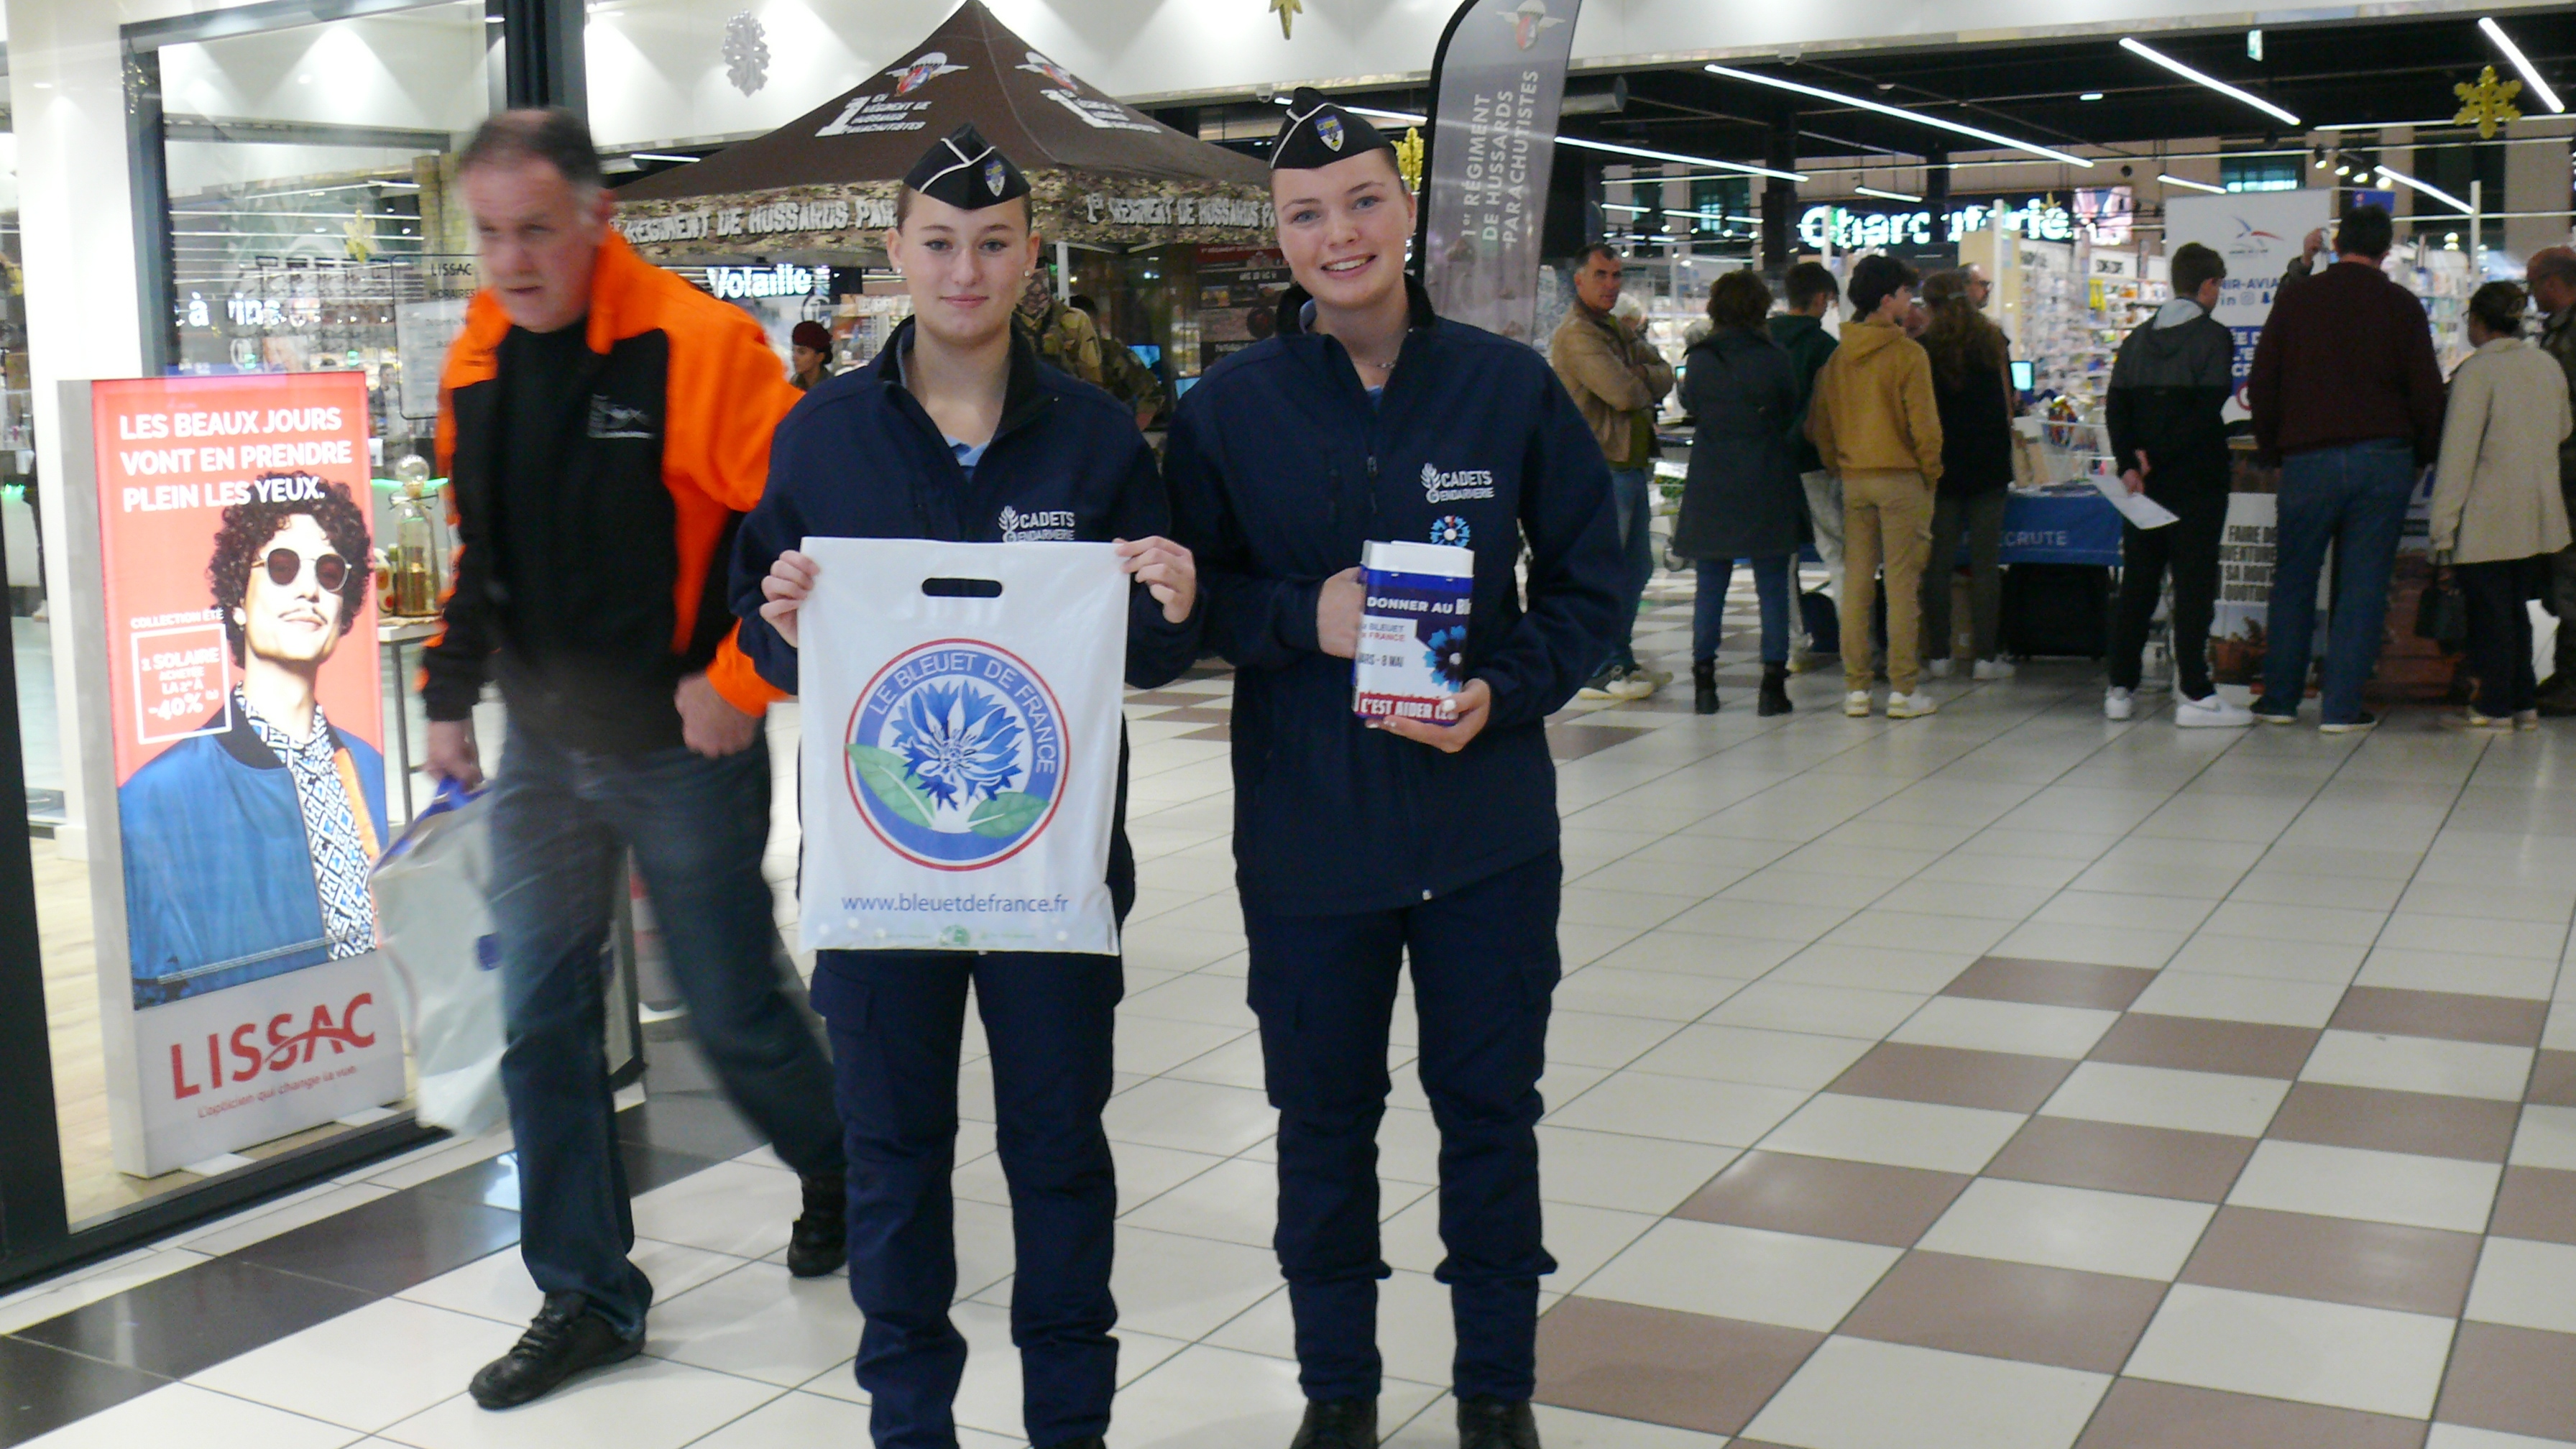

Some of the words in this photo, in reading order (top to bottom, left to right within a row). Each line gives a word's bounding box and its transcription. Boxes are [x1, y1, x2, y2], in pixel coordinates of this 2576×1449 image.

[1462, 94, 1491, 206] RÉGIMENT
[1486, 91, 1514, 206] HUSSARDS
[1503, 70, 1539, 243] PARACHUTISTES
[717, 206, 742, 236] DE
[748, 200, 849, 234] HUSSARDS
[855, 197, 898, 229] PAR
[1482, 213, 1499, 241] DE
[431, 262, 472, 276] LISSAC
[706, 263, 813, 299] Volaille
[119, 413, 169, 441] LES
[174, 410, 259, 438] BEAUX
[262, 407, 342, 435] JOURS
[120, 448, 196, 477] VONT
[199, 447, 236, 472] EN
[241, 441, 353, 469] PRENDRE
[1441, 470, 1493, 488] CADETS
[123, 484, 199, 512] PLEIN
[205, 480, 252, 507] LES
[252, 476, 326, 504] YEUX.
[1020, 511, 1075, 528] CADETS
[1366, 596, 1429, 612] DONNER
[1431, 602, 1453, 615] AU
[131, 612, 201, 629] COLLECTION
[1369, 623, 1405, 633] BLEUET
[1369, 632, 1405, 642] FRANCE
[152, 647, 221, 669] SOLAIRE
[162, 681, 180, 695] LA
[148, 692, 203, 720] -40%
[870, 685, 898, 715] LE
[893, 652, 978, 690] BLEUET
[984, 659, 1018, 689] DE
[1014, 684, 1057, 774] FRANCE
[1361, 698, 1394, 715] C'EST
[1394, 702, 1433, 718] AIDER
[841, 893, 1070, 913] www.bleuetdefrance.fr
[170, 993, 375, 1100] LISSAC
[198, 1094, 255, 1118] L'opticien
[257, 1087, 277, 1101] qui
[277, 1075, 321, 1095] change
[335, 1065, 357, 1077] vue
